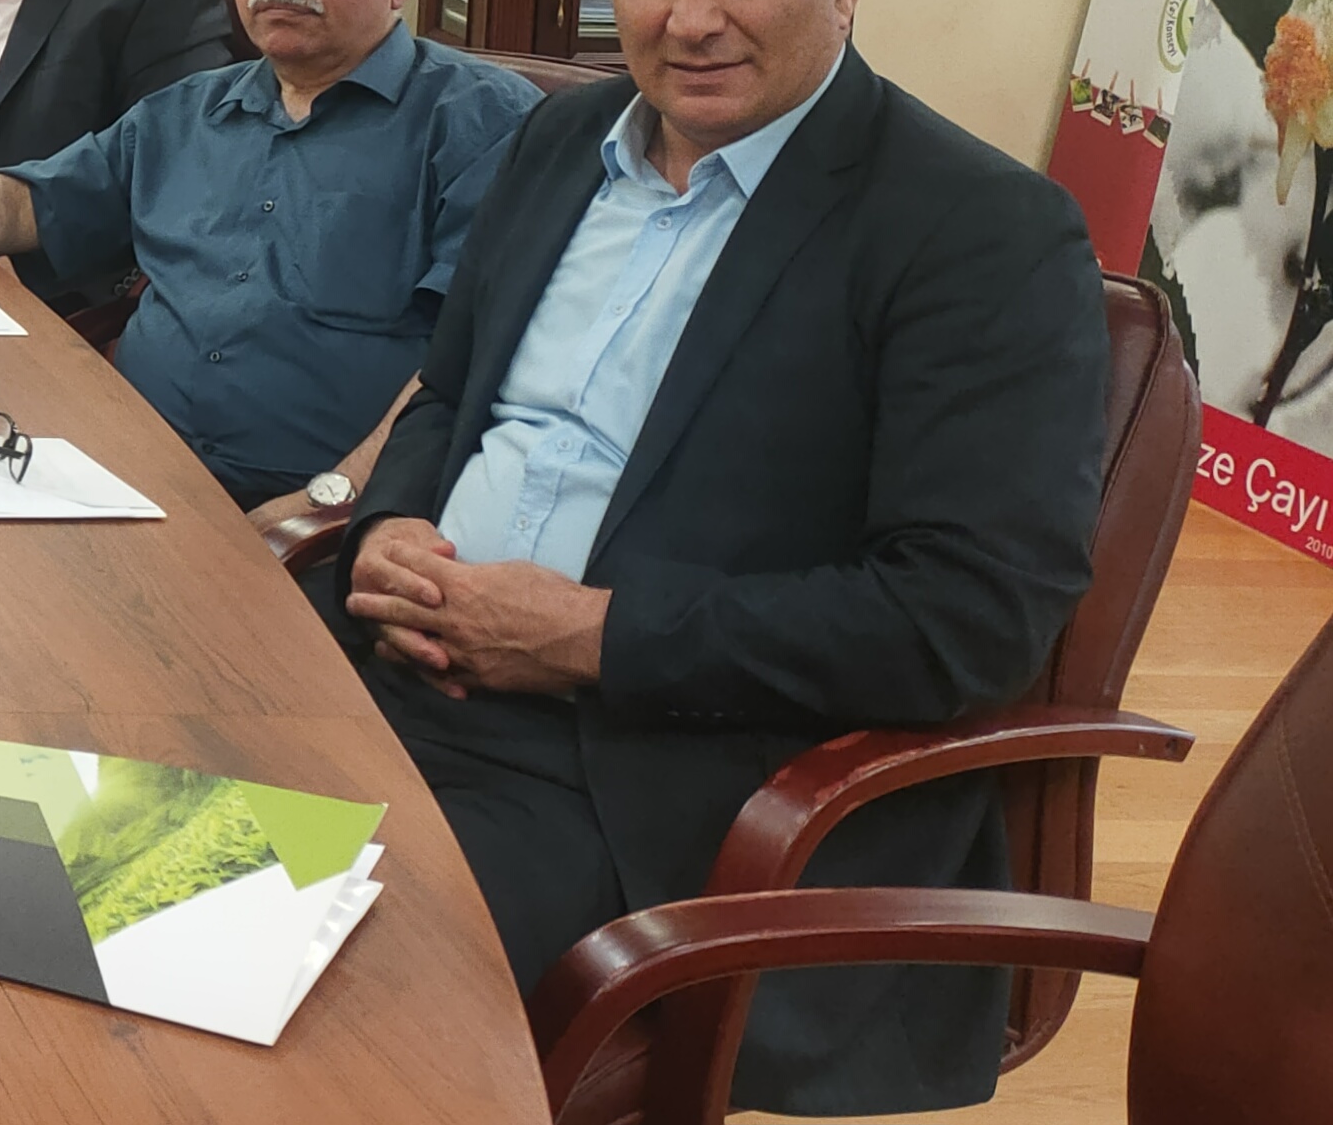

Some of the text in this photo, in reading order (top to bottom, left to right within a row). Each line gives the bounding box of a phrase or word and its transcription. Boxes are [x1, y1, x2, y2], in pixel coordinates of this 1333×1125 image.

[1166, 19, 1178, 57] Konseyi
[1196, 442, 1329, 533] ze Çayı
